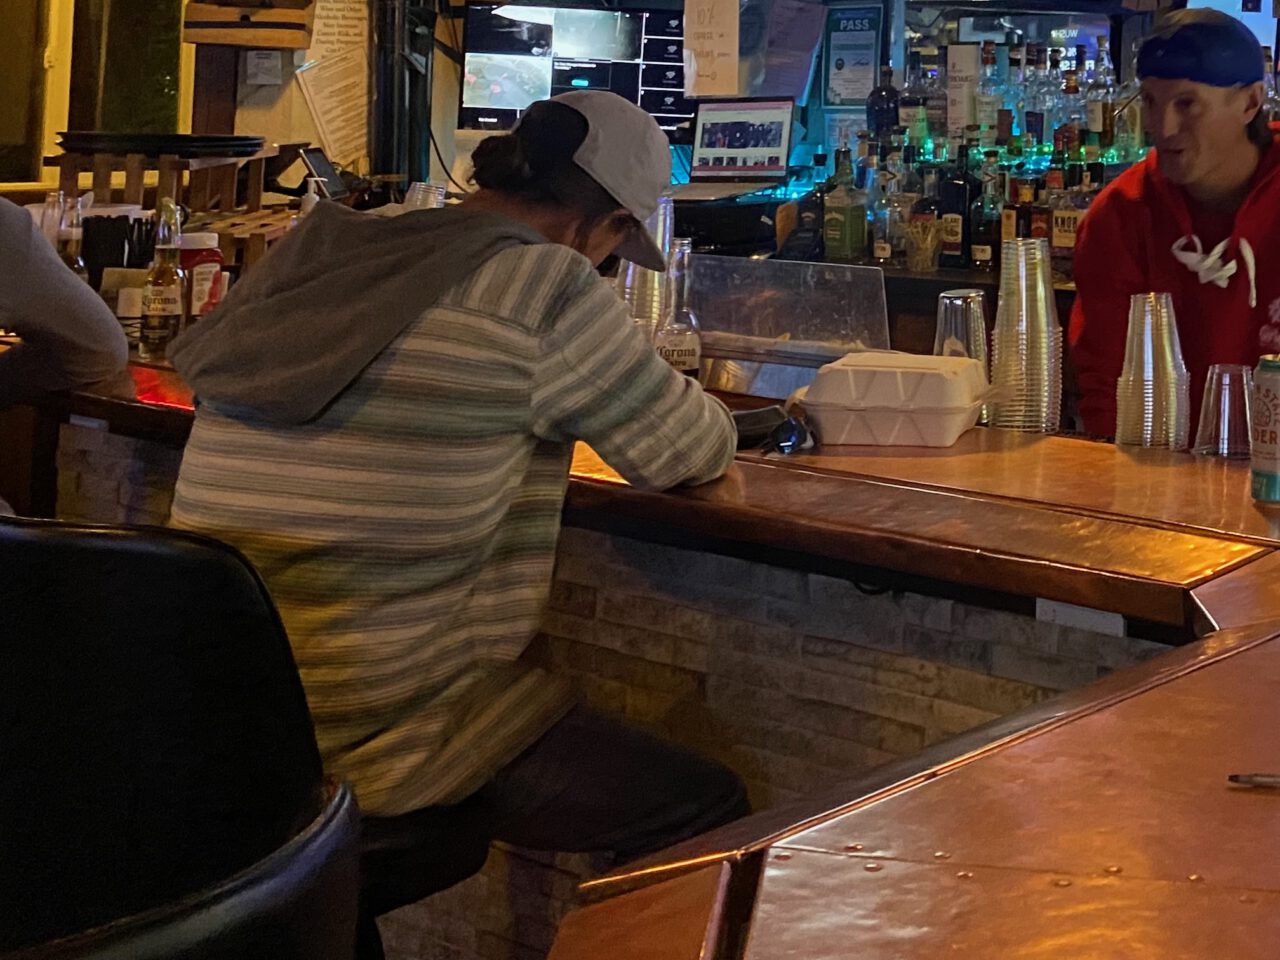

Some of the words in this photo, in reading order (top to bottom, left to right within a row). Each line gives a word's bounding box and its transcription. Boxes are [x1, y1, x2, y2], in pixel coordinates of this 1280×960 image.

[840, 19, 870, 31] PASS
[656, 345, 696, 359] Corona
[1253, 428, 1278, 445] DER
